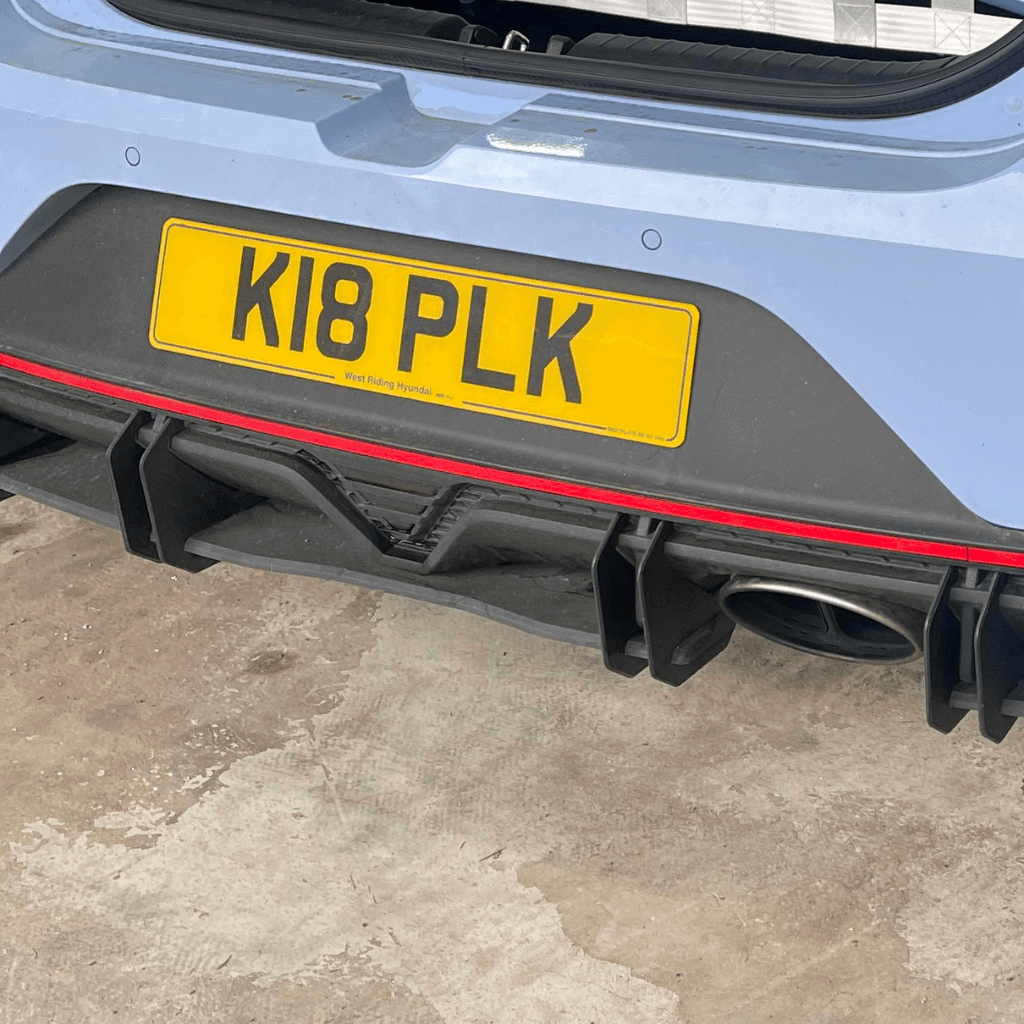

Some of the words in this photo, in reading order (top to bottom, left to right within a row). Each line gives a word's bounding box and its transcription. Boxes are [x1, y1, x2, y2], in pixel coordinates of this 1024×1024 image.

[231, 245, 374, 362] K18
[397, 273, 594, 405] PLK
[345, 371, 366, 384] West
[367, 375, 395, 391] Riding
[397, 380, 432, 396] Hyundai
